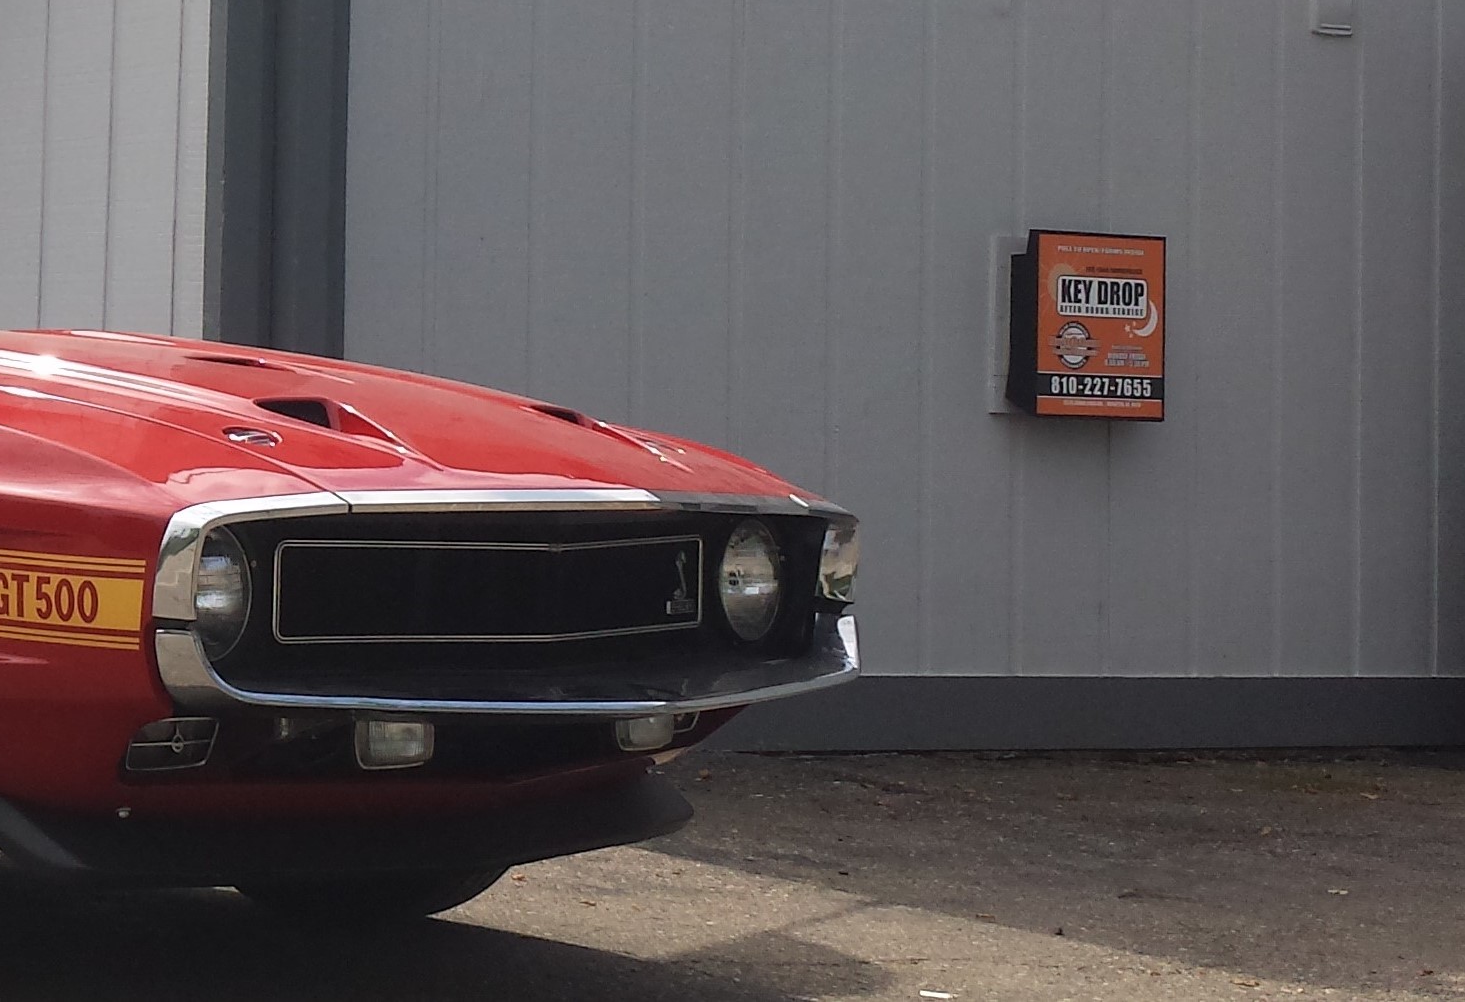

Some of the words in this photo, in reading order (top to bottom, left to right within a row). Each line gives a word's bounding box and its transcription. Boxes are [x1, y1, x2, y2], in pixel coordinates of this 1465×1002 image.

[1061, 278, 1093, 304] KEY
[1097, 281, 1145, 307] DROP
[1051, 376, 1152, 397] 810-227-7655
[36, 575, 99, 624] 500
